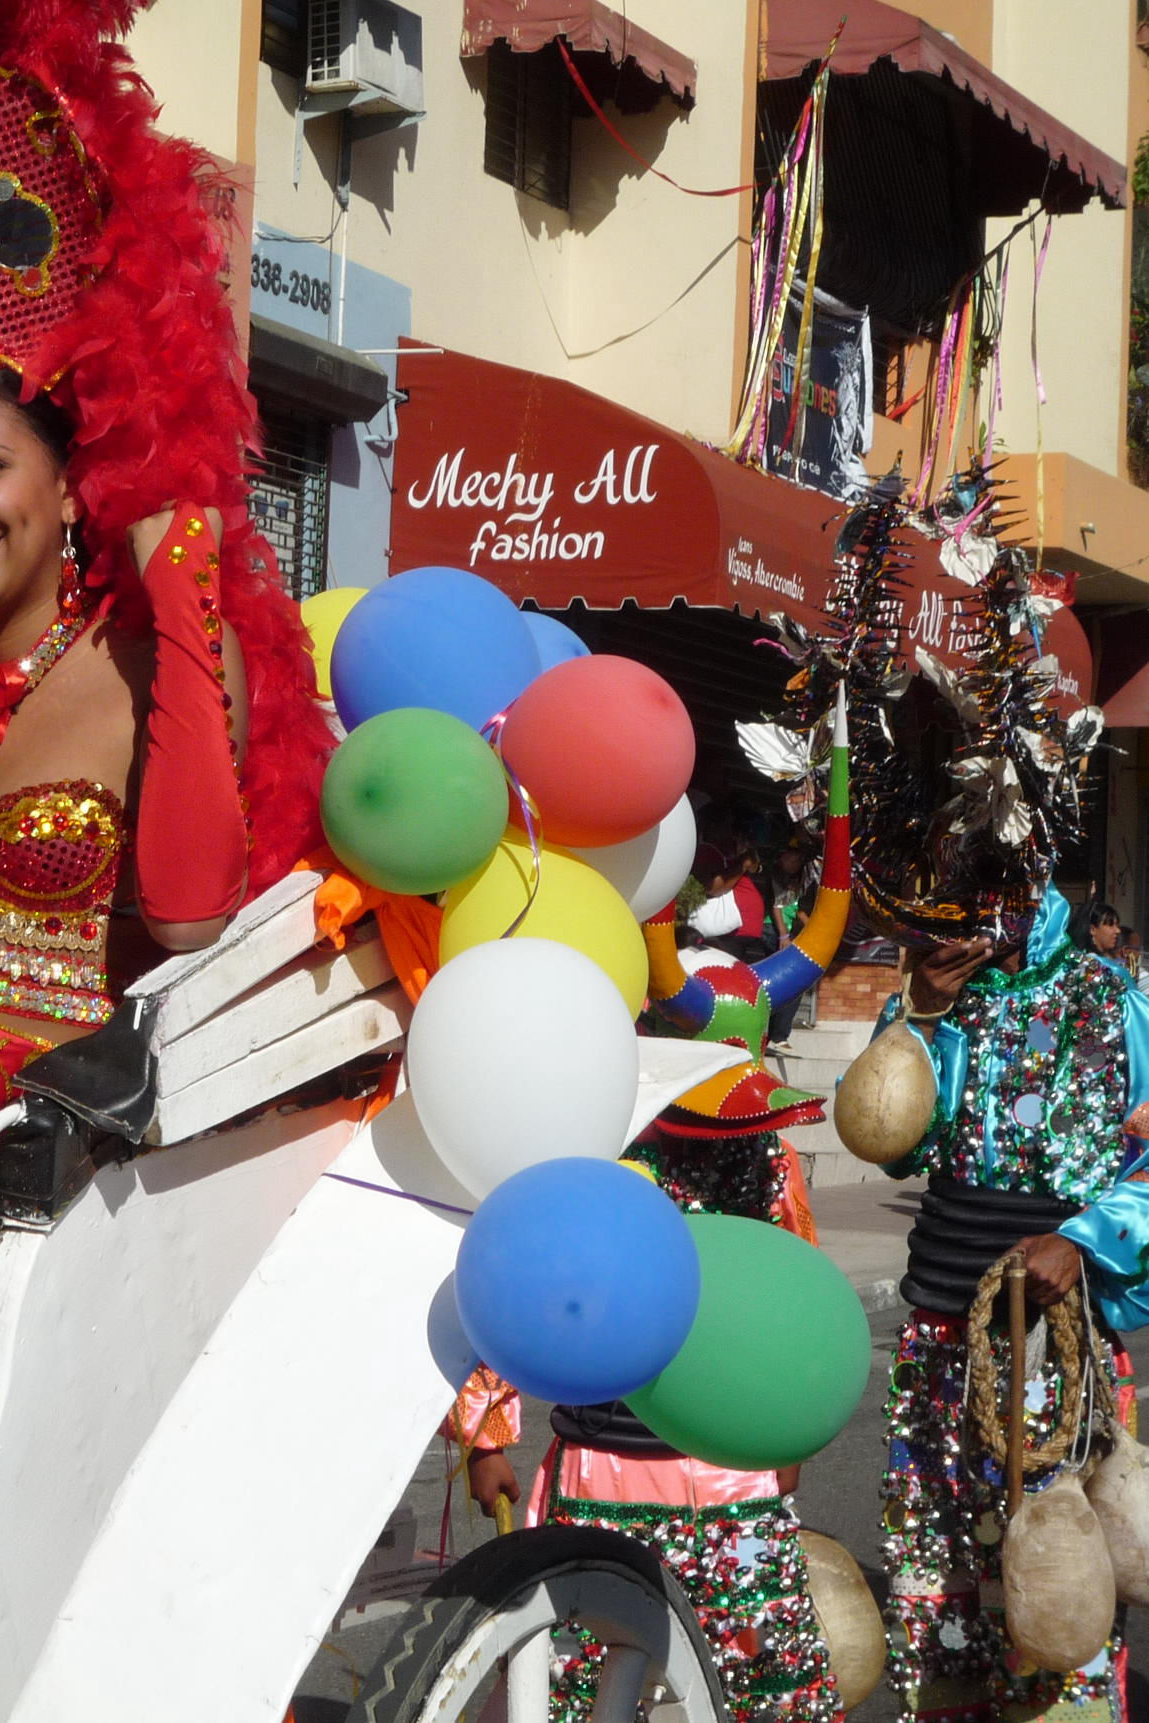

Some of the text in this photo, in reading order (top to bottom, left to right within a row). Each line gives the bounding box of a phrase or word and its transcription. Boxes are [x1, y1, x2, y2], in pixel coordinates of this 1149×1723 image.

[408, 444, 660, 525] Mechy All
[469, 516, 605, 567] fashion
[754, 558, 805, 601] Abercrombie
